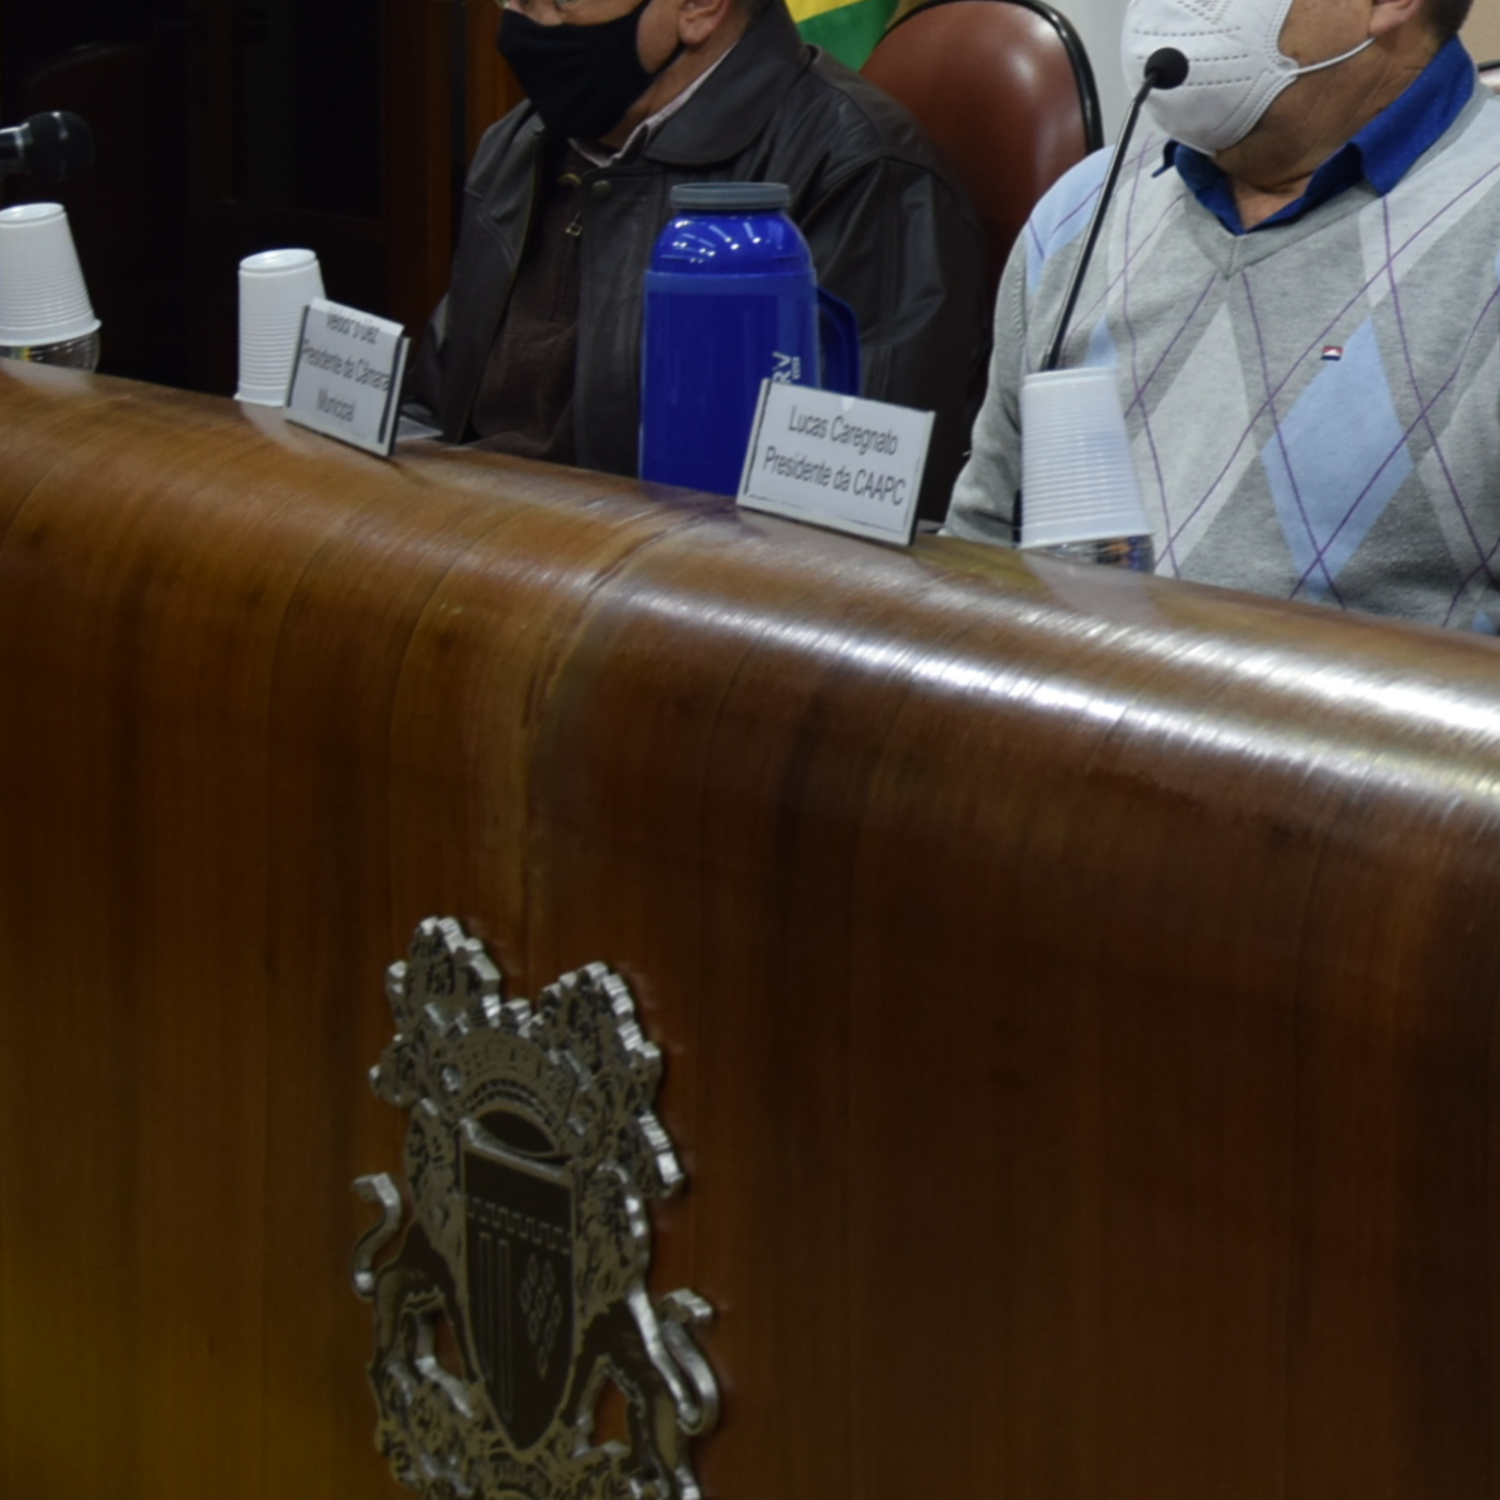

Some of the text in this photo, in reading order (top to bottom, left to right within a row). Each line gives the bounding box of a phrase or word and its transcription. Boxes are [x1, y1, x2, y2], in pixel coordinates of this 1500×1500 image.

[788, 405, 898, 456] Lucas Caregnato
[763, 446, 907, 506] Presidente da CAAPC
